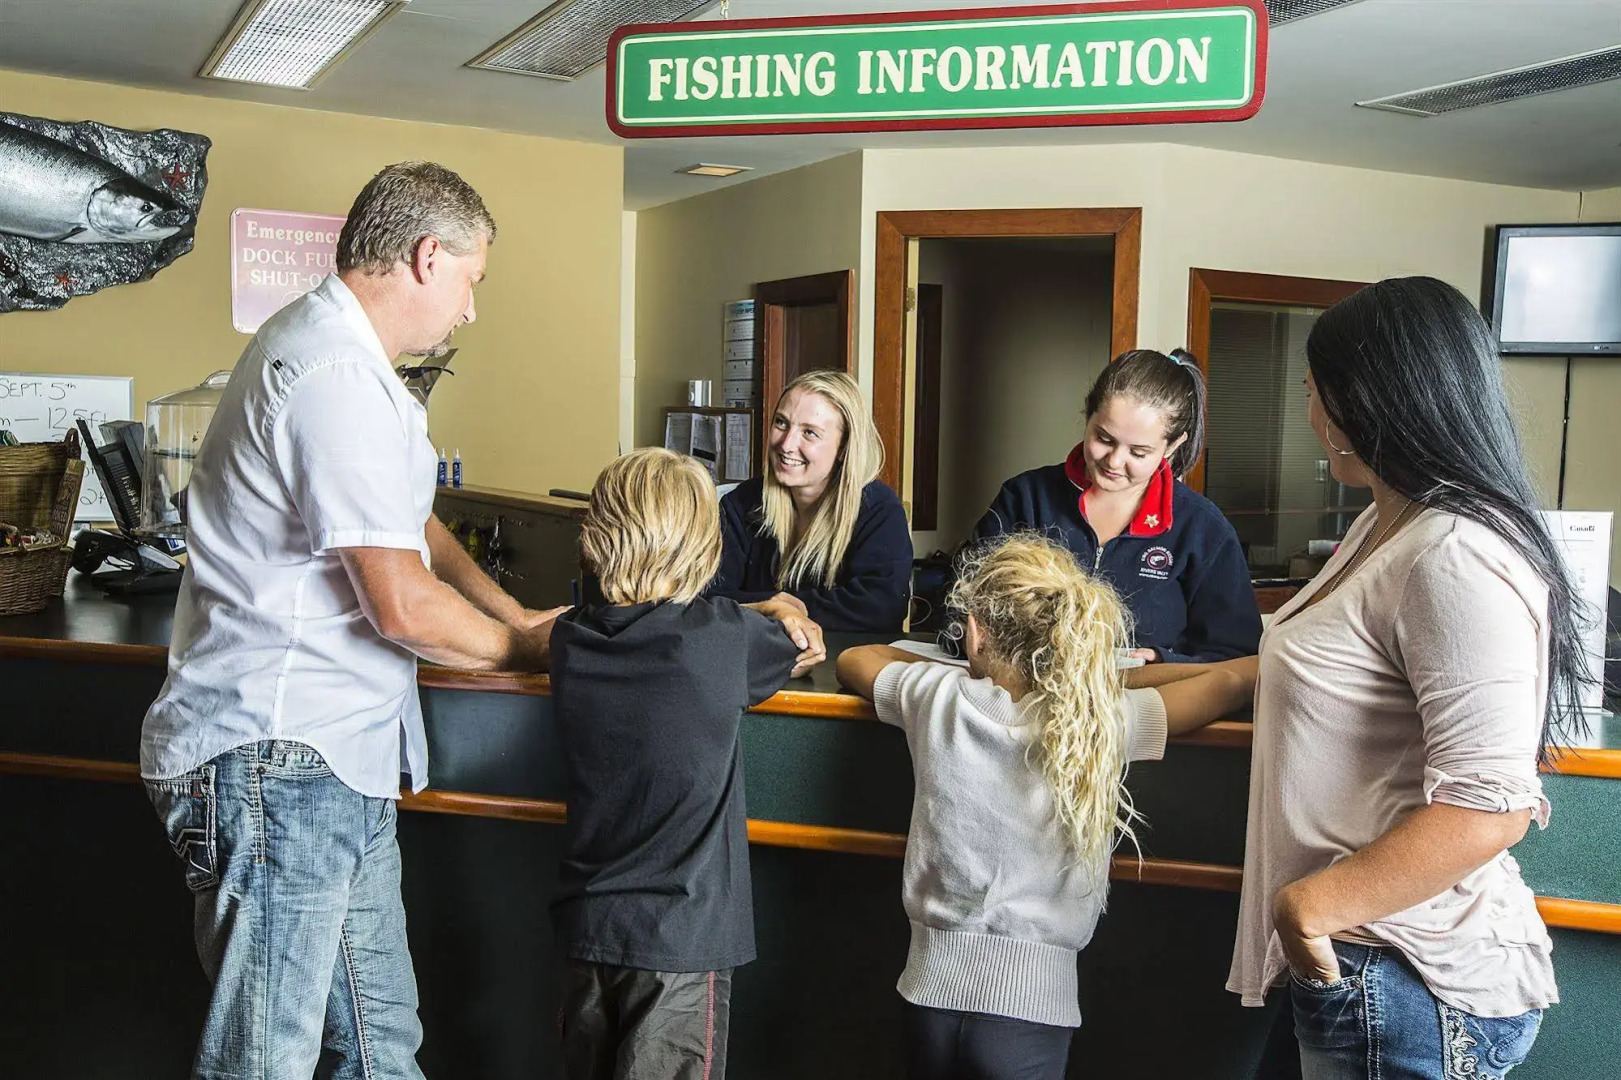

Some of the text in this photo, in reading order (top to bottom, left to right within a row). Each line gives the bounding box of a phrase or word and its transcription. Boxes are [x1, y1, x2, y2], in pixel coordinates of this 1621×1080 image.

[648, 36, 1212, 101] FISHING INFORMATION
[243, 247, 337, 268] DOCK FUE
[250, 269, 322, 288] SHUT-O
[0, 377, 42, 399] SEPT.
